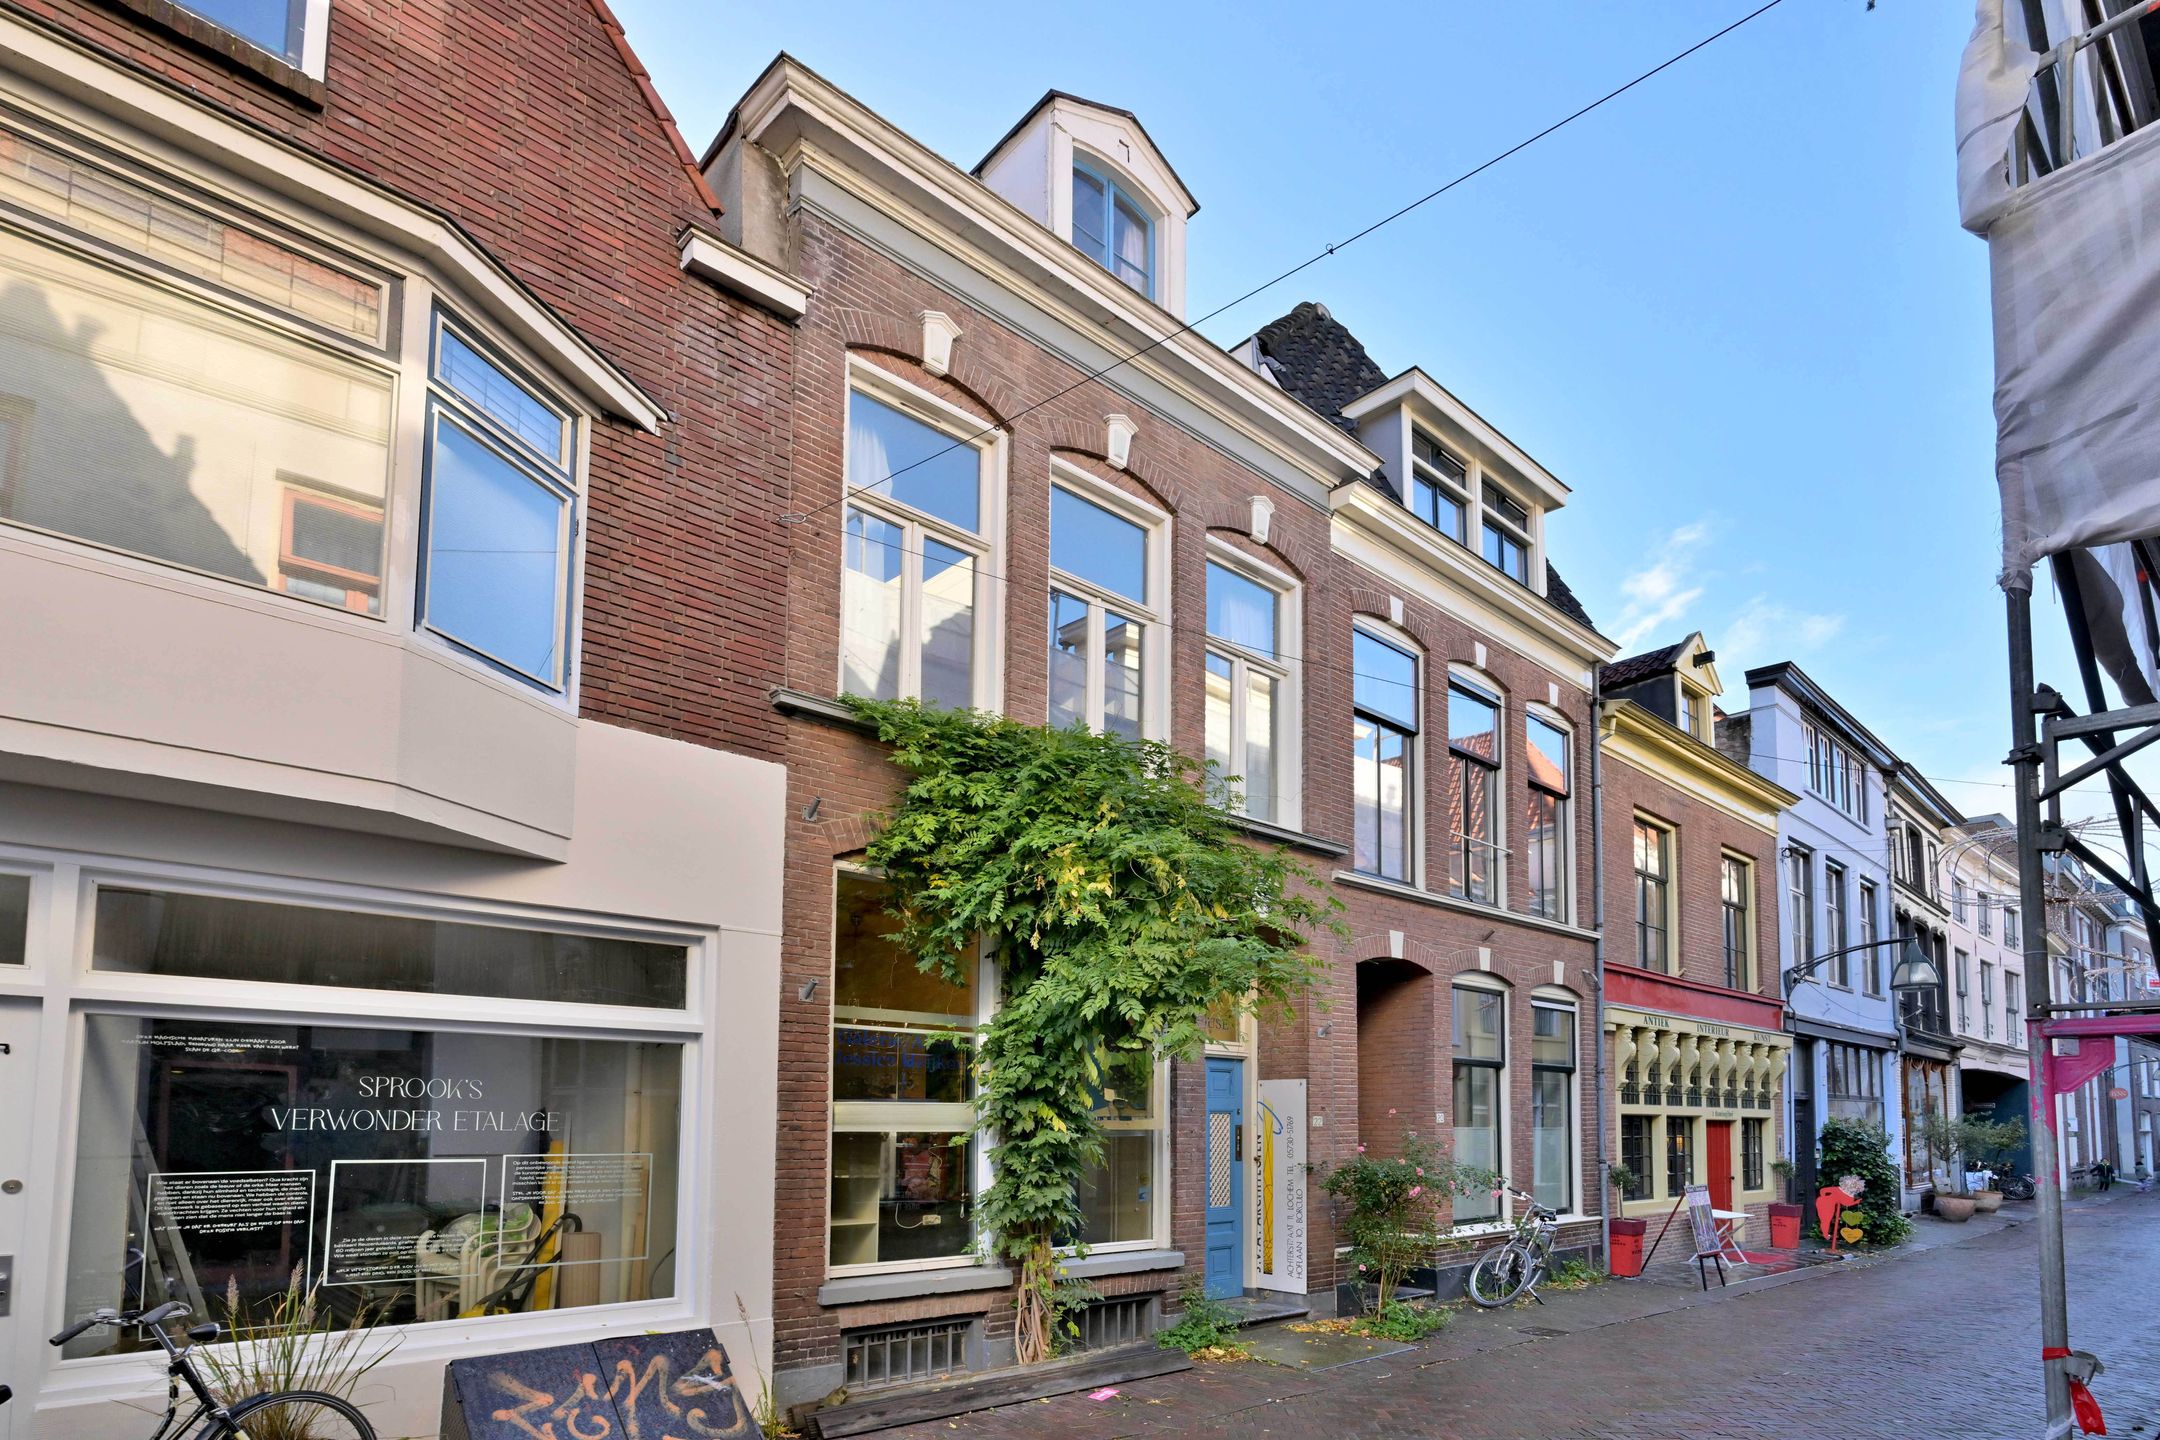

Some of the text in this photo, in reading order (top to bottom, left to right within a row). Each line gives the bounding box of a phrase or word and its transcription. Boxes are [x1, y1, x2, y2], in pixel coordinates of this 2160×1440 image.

[1643, 1016, 1771, 1042] ANTIEK INTERIEUR KUNST
[358, 1076, 482, 1099] SPROOK'S
[272, 1108, 560, 1132] VERWONDER ETALAGE
